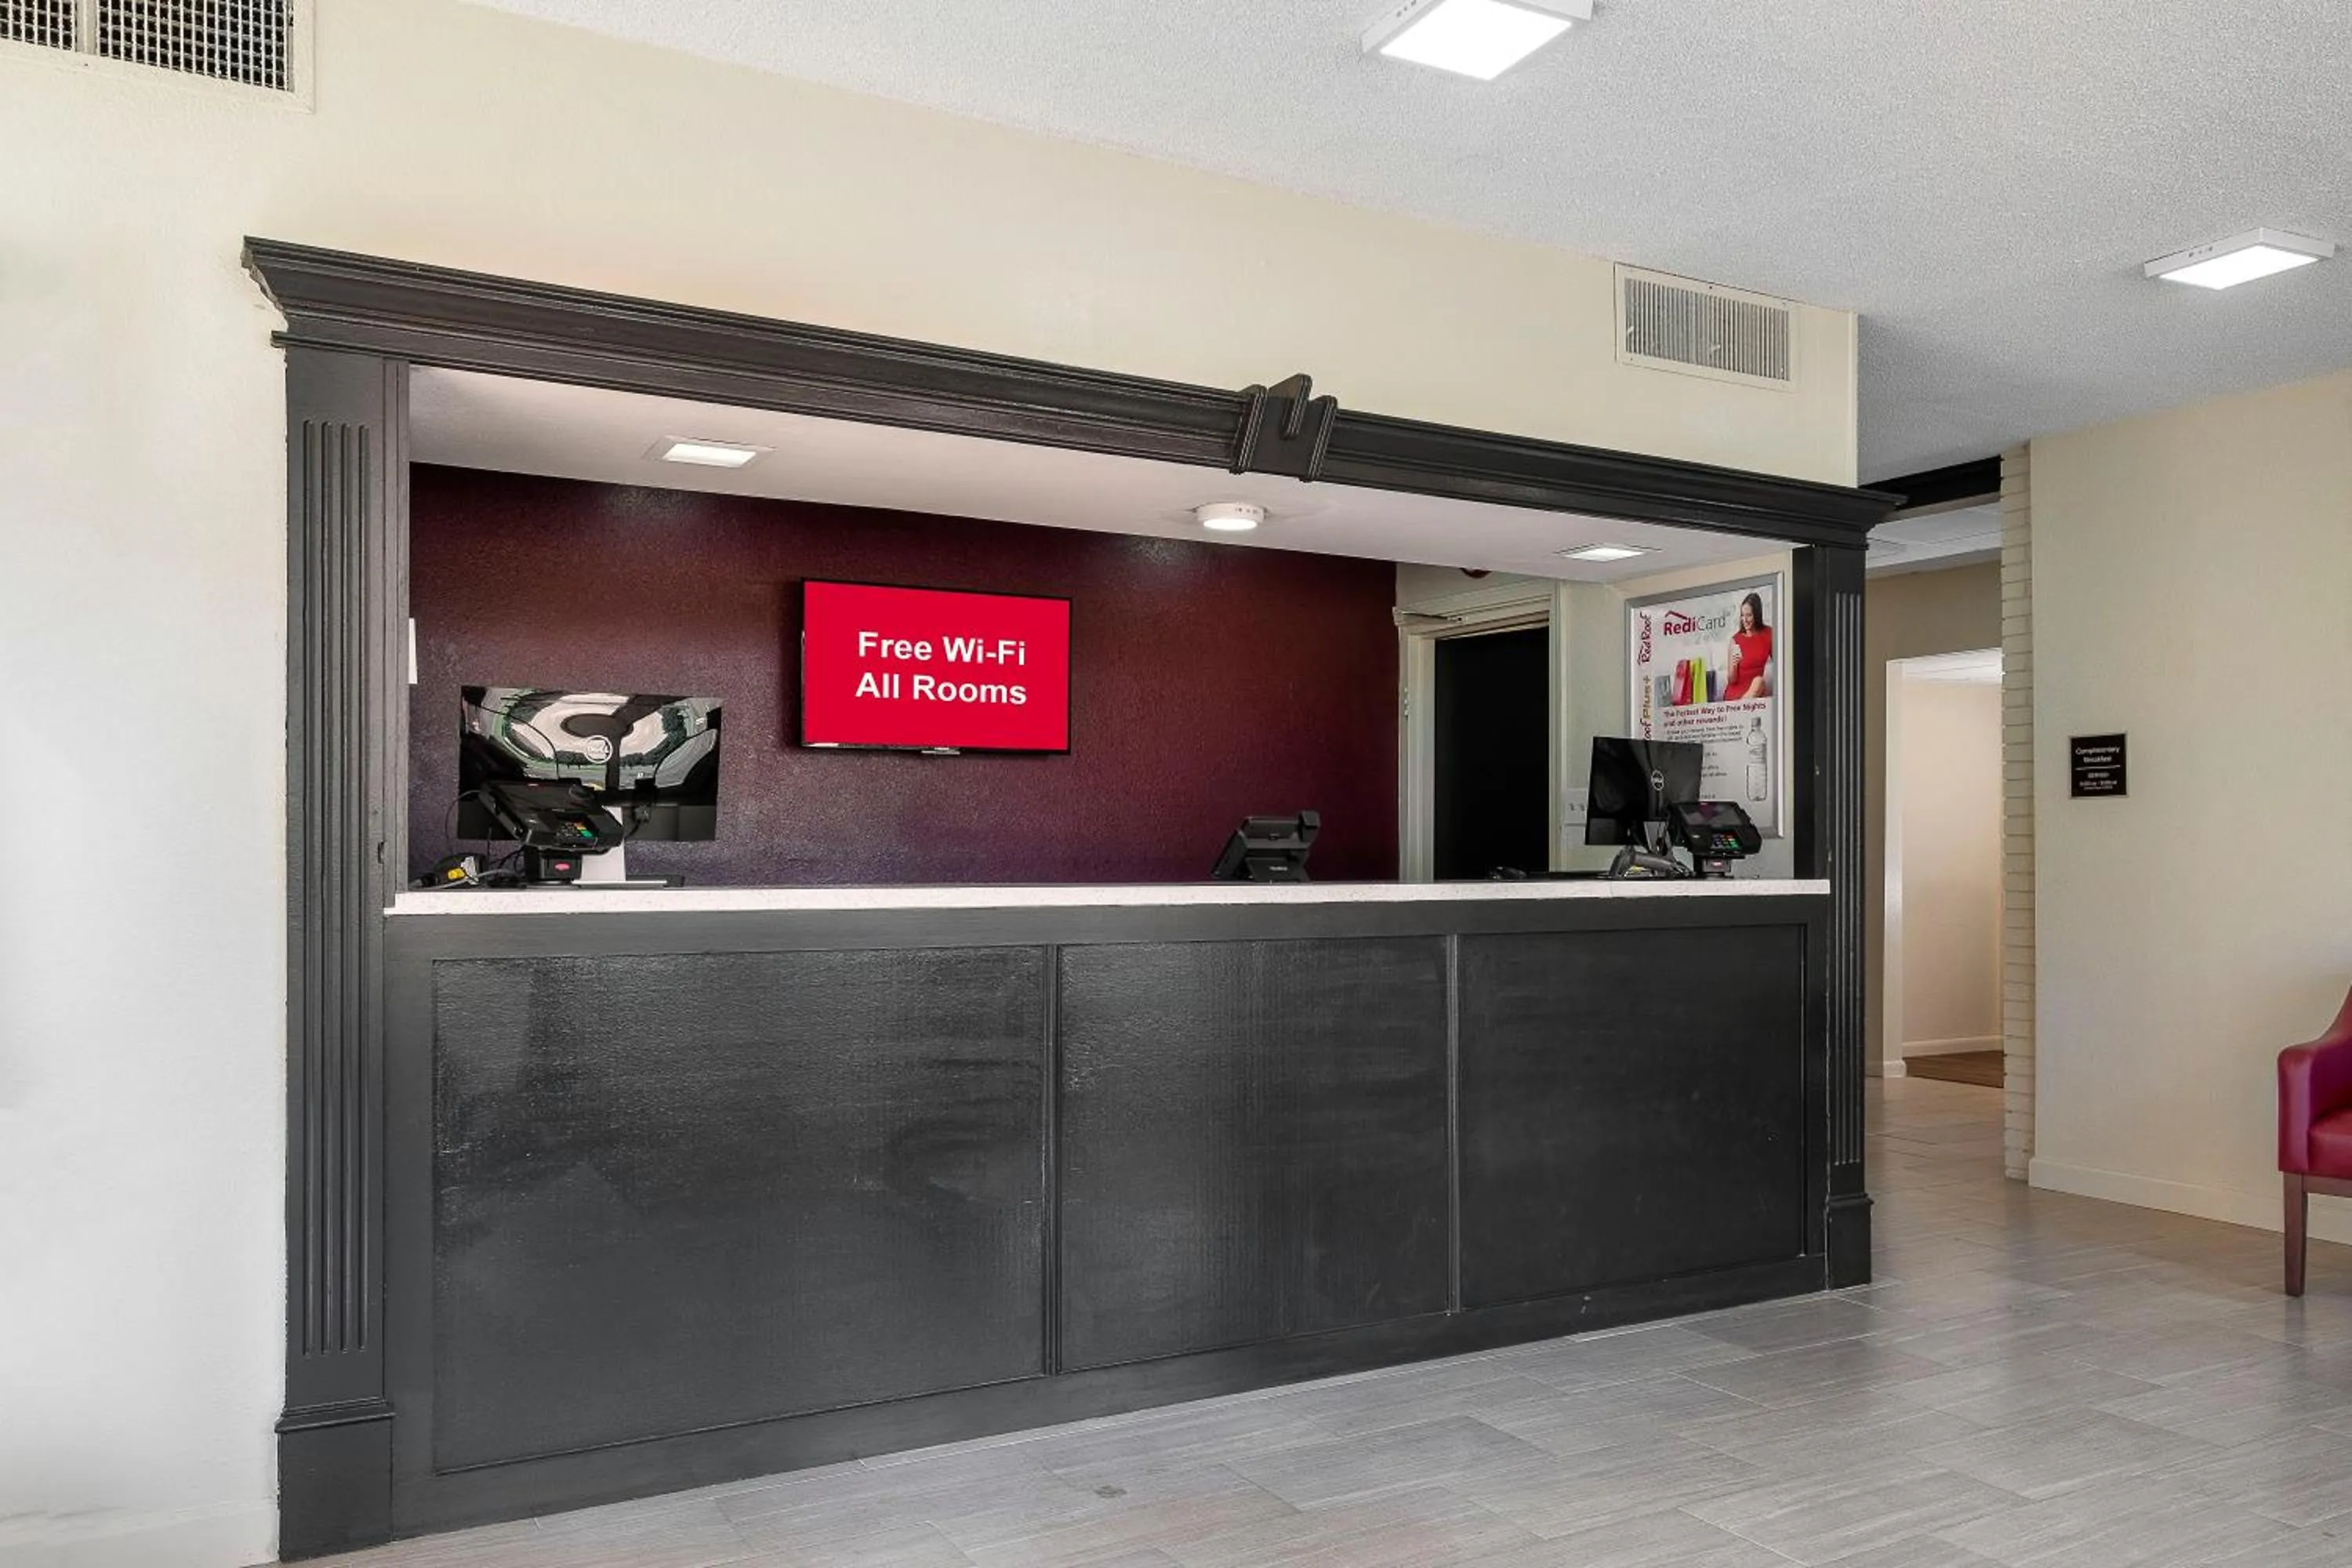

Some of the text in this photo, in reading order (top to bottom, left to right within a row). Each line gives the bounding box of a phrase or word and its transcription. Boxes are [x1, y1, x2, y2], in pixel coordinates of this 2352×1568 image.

[1663, 615, 1726, 636] RediCard
[858, 631, 1025, 666] Free Wi-Fi
[855, 672, 1027, 705] All Rooms
[1701, 706, 1715, 715] Way
[1743, 702, 1766, 712] Nights
